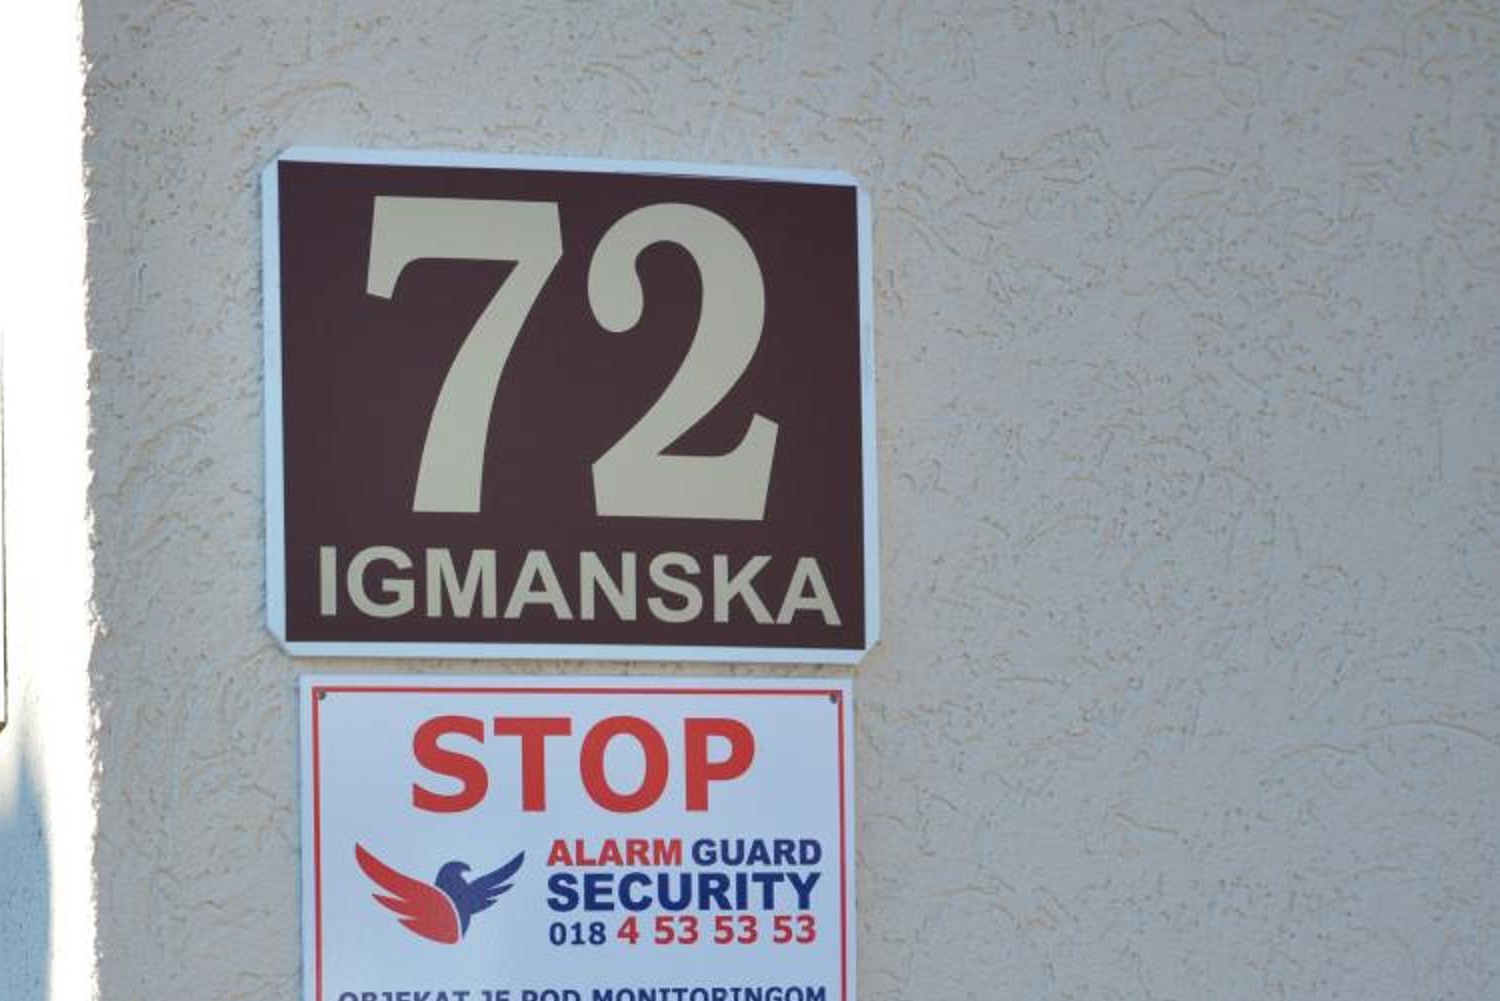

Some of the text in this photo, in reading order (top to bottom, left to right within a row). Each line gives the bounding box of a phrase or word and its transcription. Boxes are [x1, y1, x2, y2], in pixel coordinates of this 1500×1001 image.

[366, 195, 779, 521] 72
[319, 545, 842, 626] IGMANSKA
[412, 715, 756, 813] STOP
[546, 839, 822, 867] ALARM GUARD
[547, 872, 821, 912] SECURITY
[549, 915, 816, 945] 018 4 53 53 53
